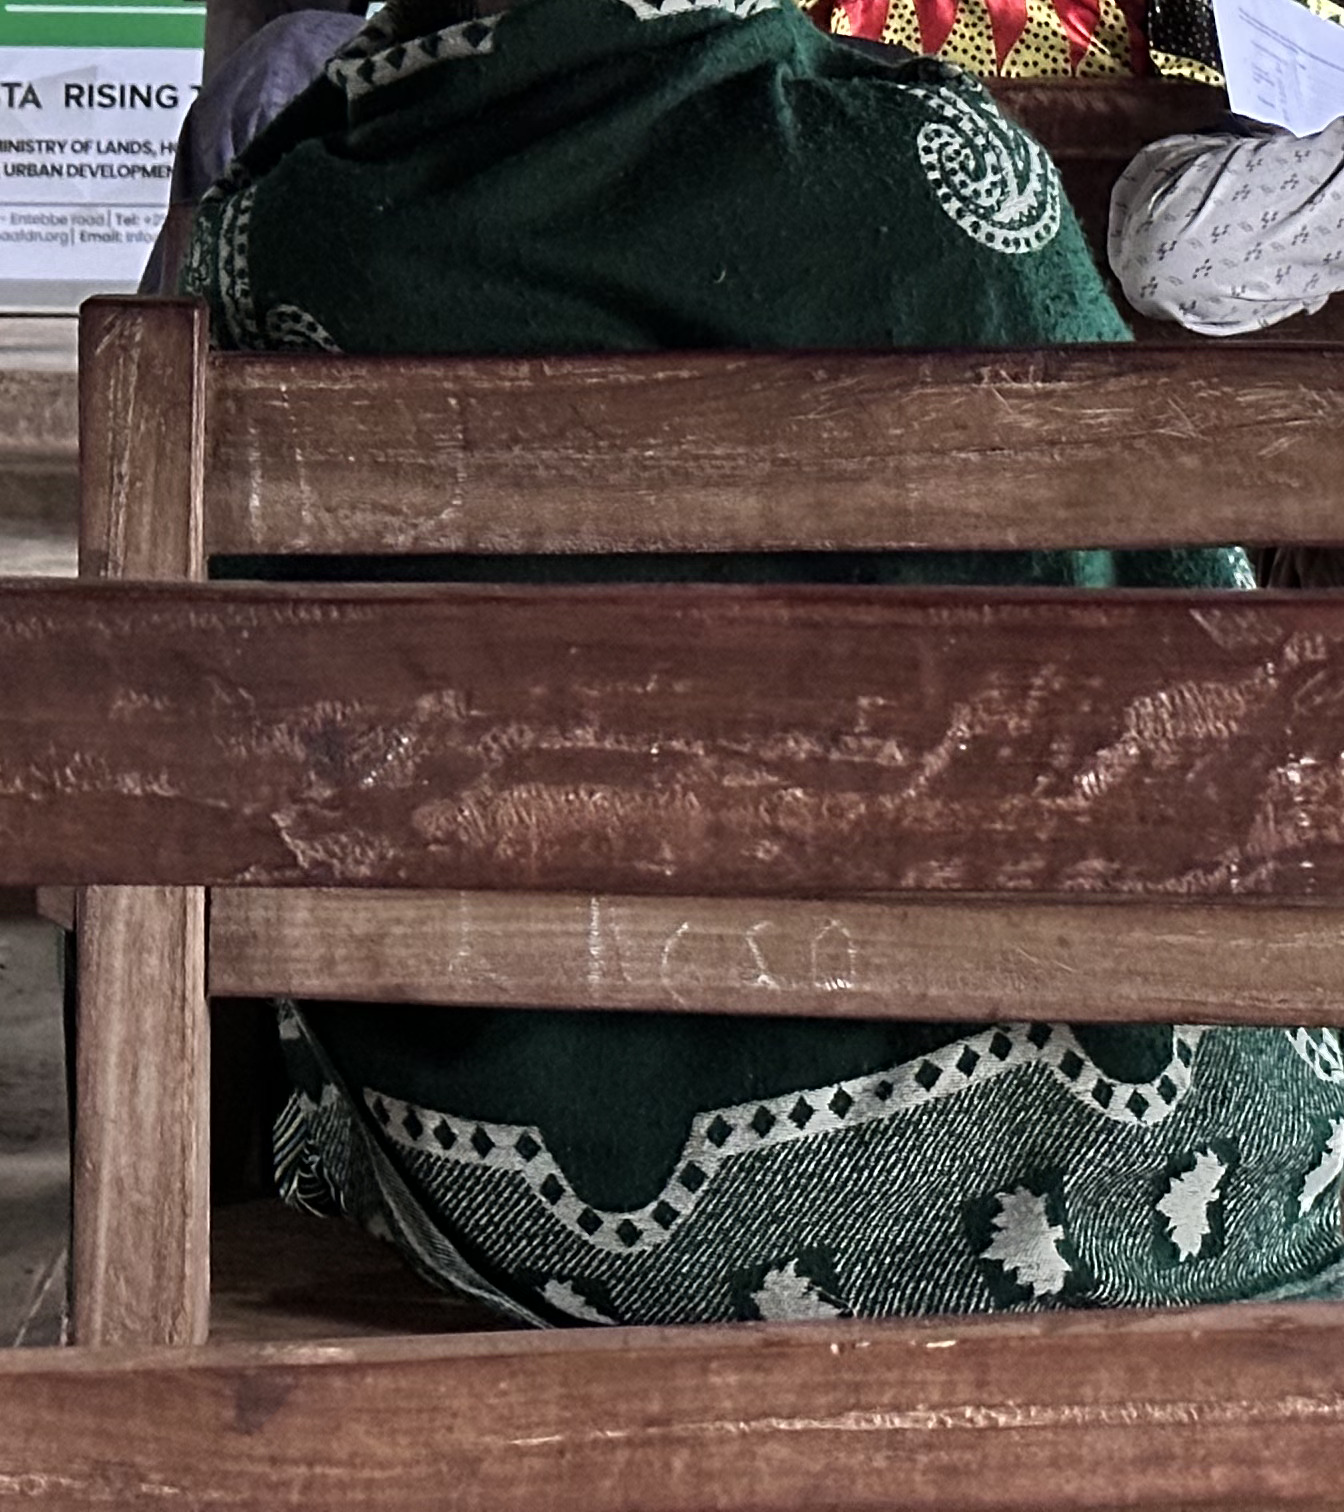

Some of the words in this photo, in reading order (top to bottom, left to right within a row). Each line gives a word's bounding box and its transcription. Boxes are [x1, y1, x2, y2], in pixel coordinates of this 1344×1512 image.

[64, 84, 179, 110] RISING
[71, 140, 92, 155] OF
[96, 140, 157, 156] LANDS,
[5, 164, 63, 178] URBAN
